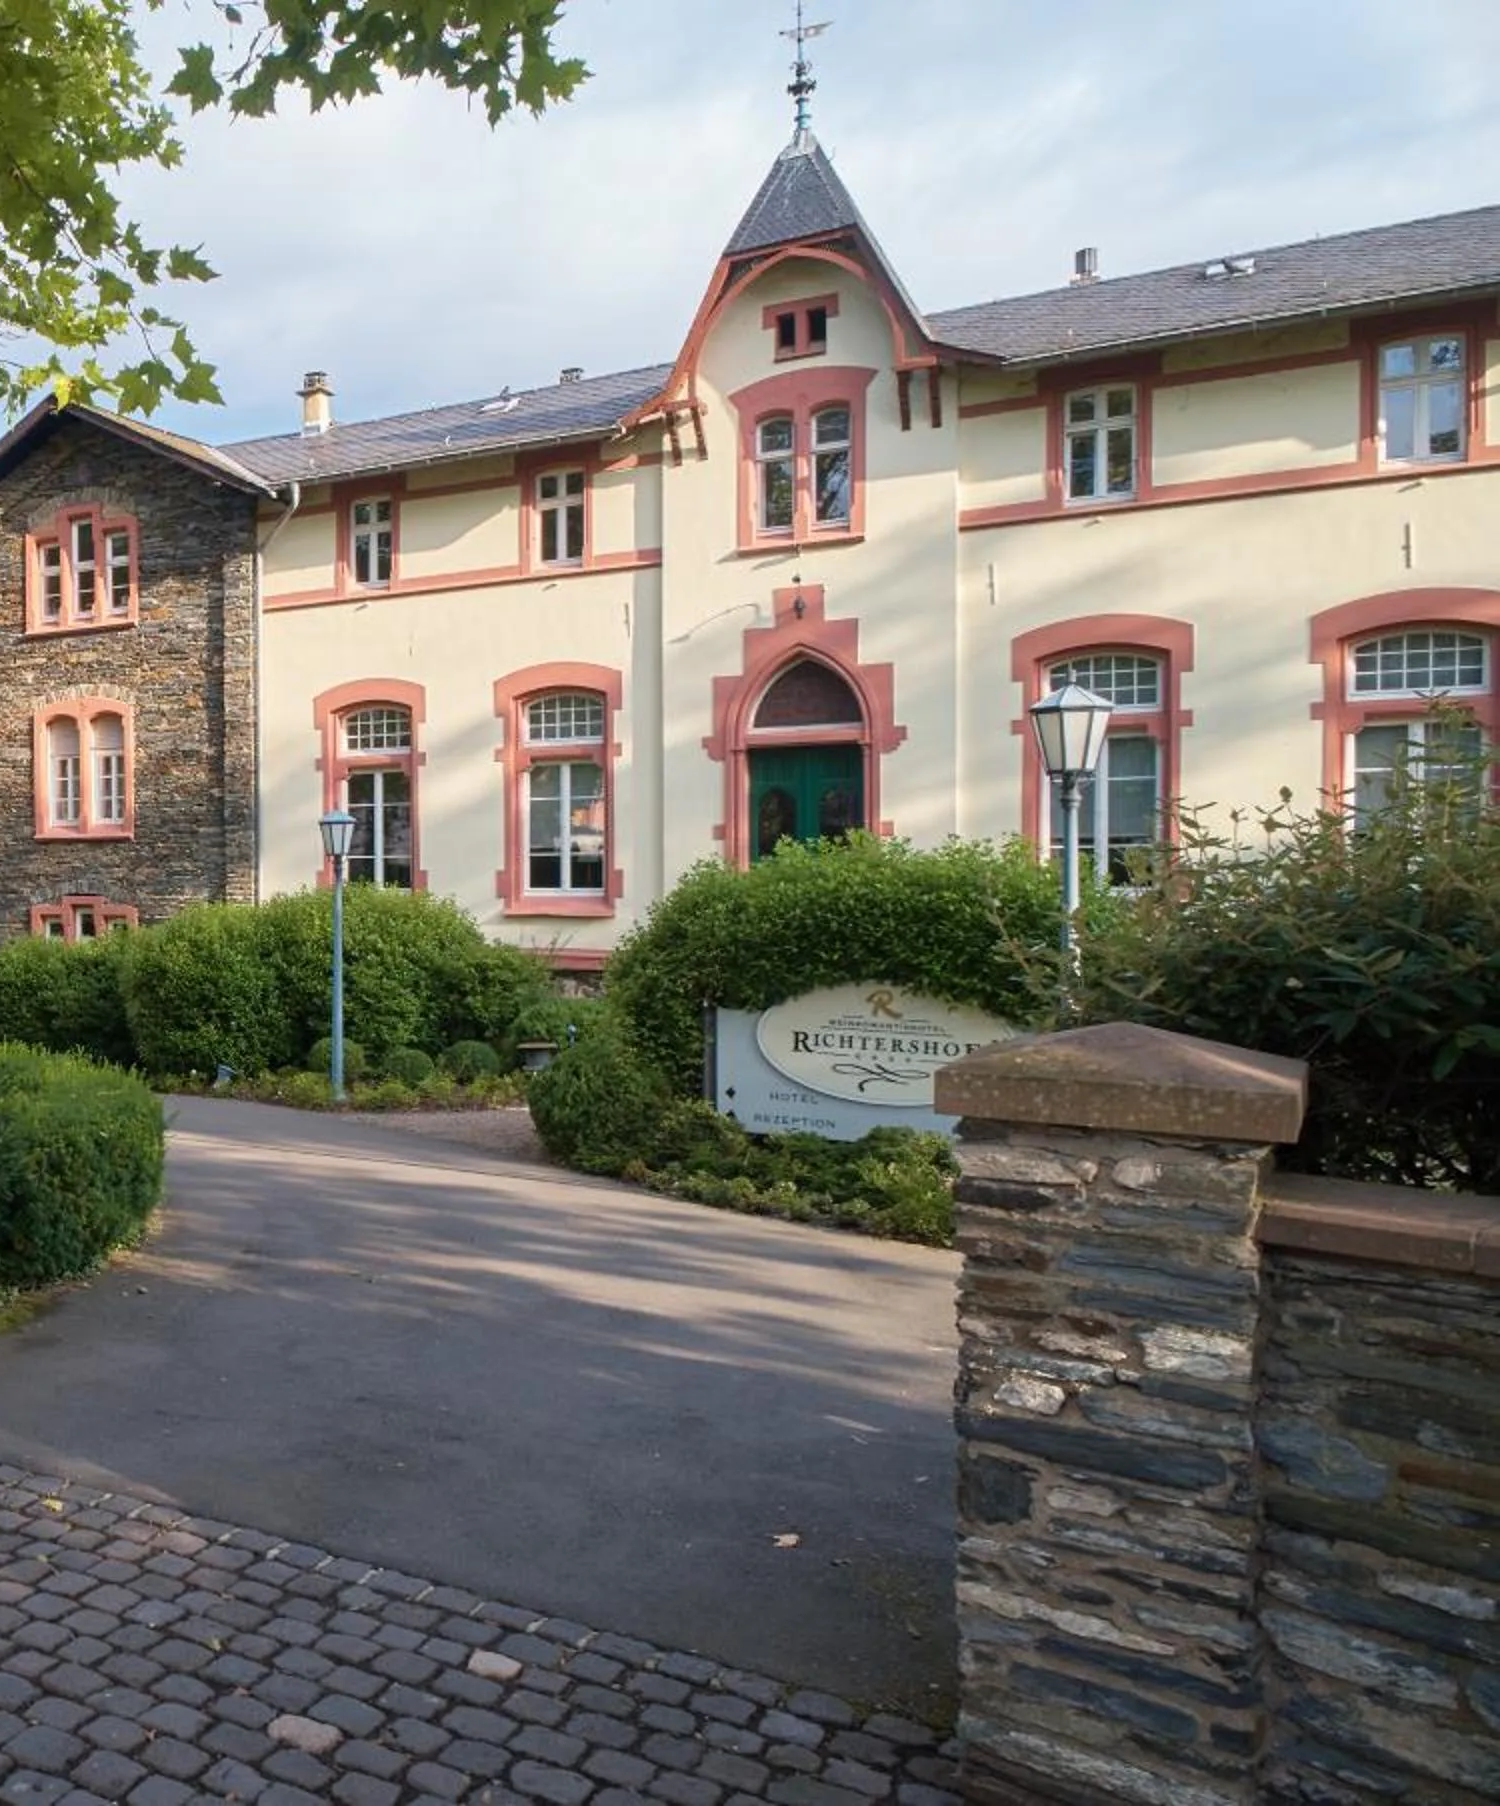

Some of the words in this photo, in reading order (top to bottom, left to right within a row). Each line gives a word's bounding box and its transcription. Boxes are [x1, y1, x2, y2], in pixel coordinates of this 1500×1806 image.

[866, 989, 903, 1019] R
[793, 1030, 980, 1057] RICHTERSHOF
[769, 1090, 819, 1105] HOTEL
[753, 1113, 836, 1129] REZEPTION
